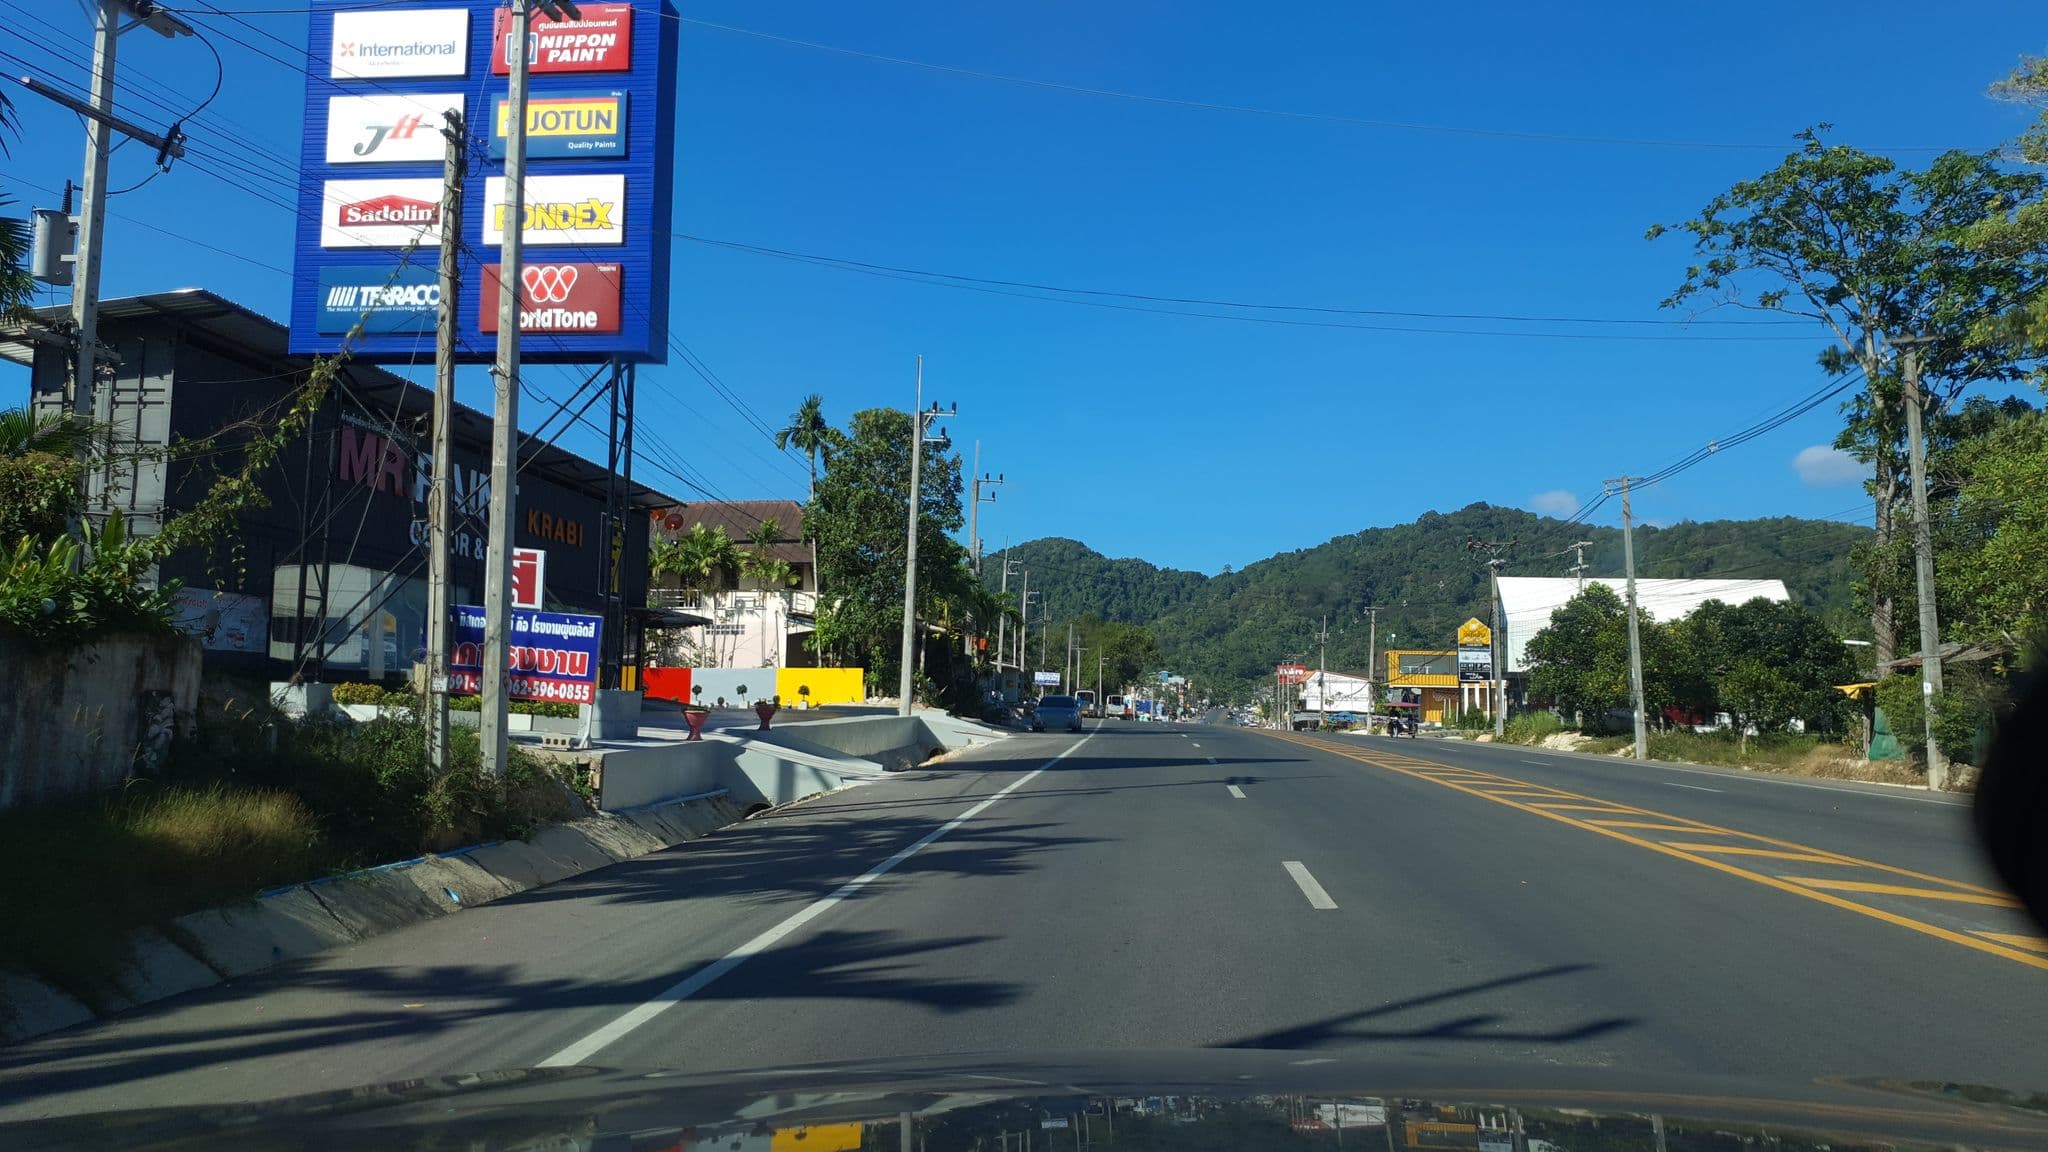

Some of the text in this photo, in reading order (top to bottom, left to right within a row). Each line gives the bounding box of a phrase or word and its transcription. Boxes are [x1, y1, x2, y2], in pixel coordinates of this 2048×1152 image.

[359, 40, 456, 57] International
[540, 33, 617, 49] NIPPON
[547, 48, 607, 63] PAINT
[529, 109, 612, 132] JOTUN
[568, 140, 616, 150] Quality Paints
[347, 205, 433, 223] Sadolin
[359, 284, 440, 306] TERRACO
[520, 307, 597, 328] orldTone
[339, 425, 405, 497] MR
[527, 506, 585, 548] KRABI
[474, 537, 485, 561] &
